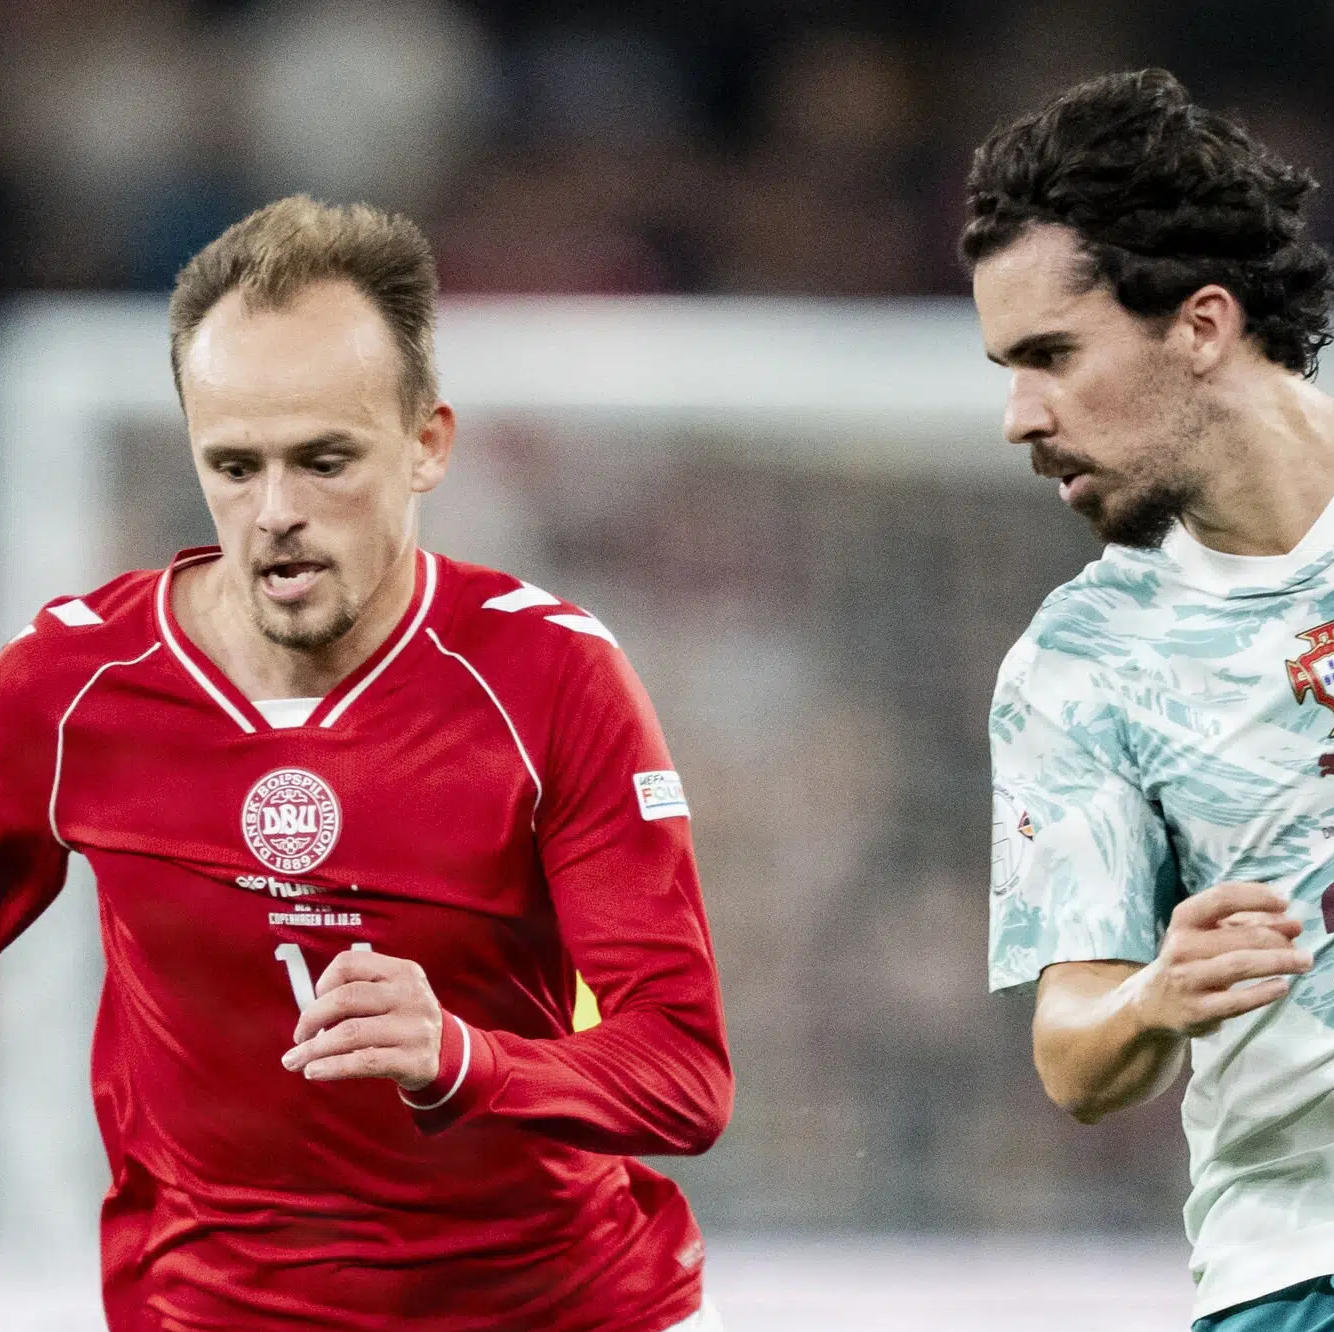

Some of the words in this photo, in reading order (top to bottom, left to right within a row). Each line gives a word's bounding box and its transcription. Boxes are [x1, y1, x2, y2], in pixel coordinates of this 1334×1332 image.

[247, 800, 271, 859] DANSK
[313, 801, 335, 855] UNION
[262, 804, 317, 835] DBU
[275, 855, 311, 870] 1889
[274, 942, 373, 1013] 1
